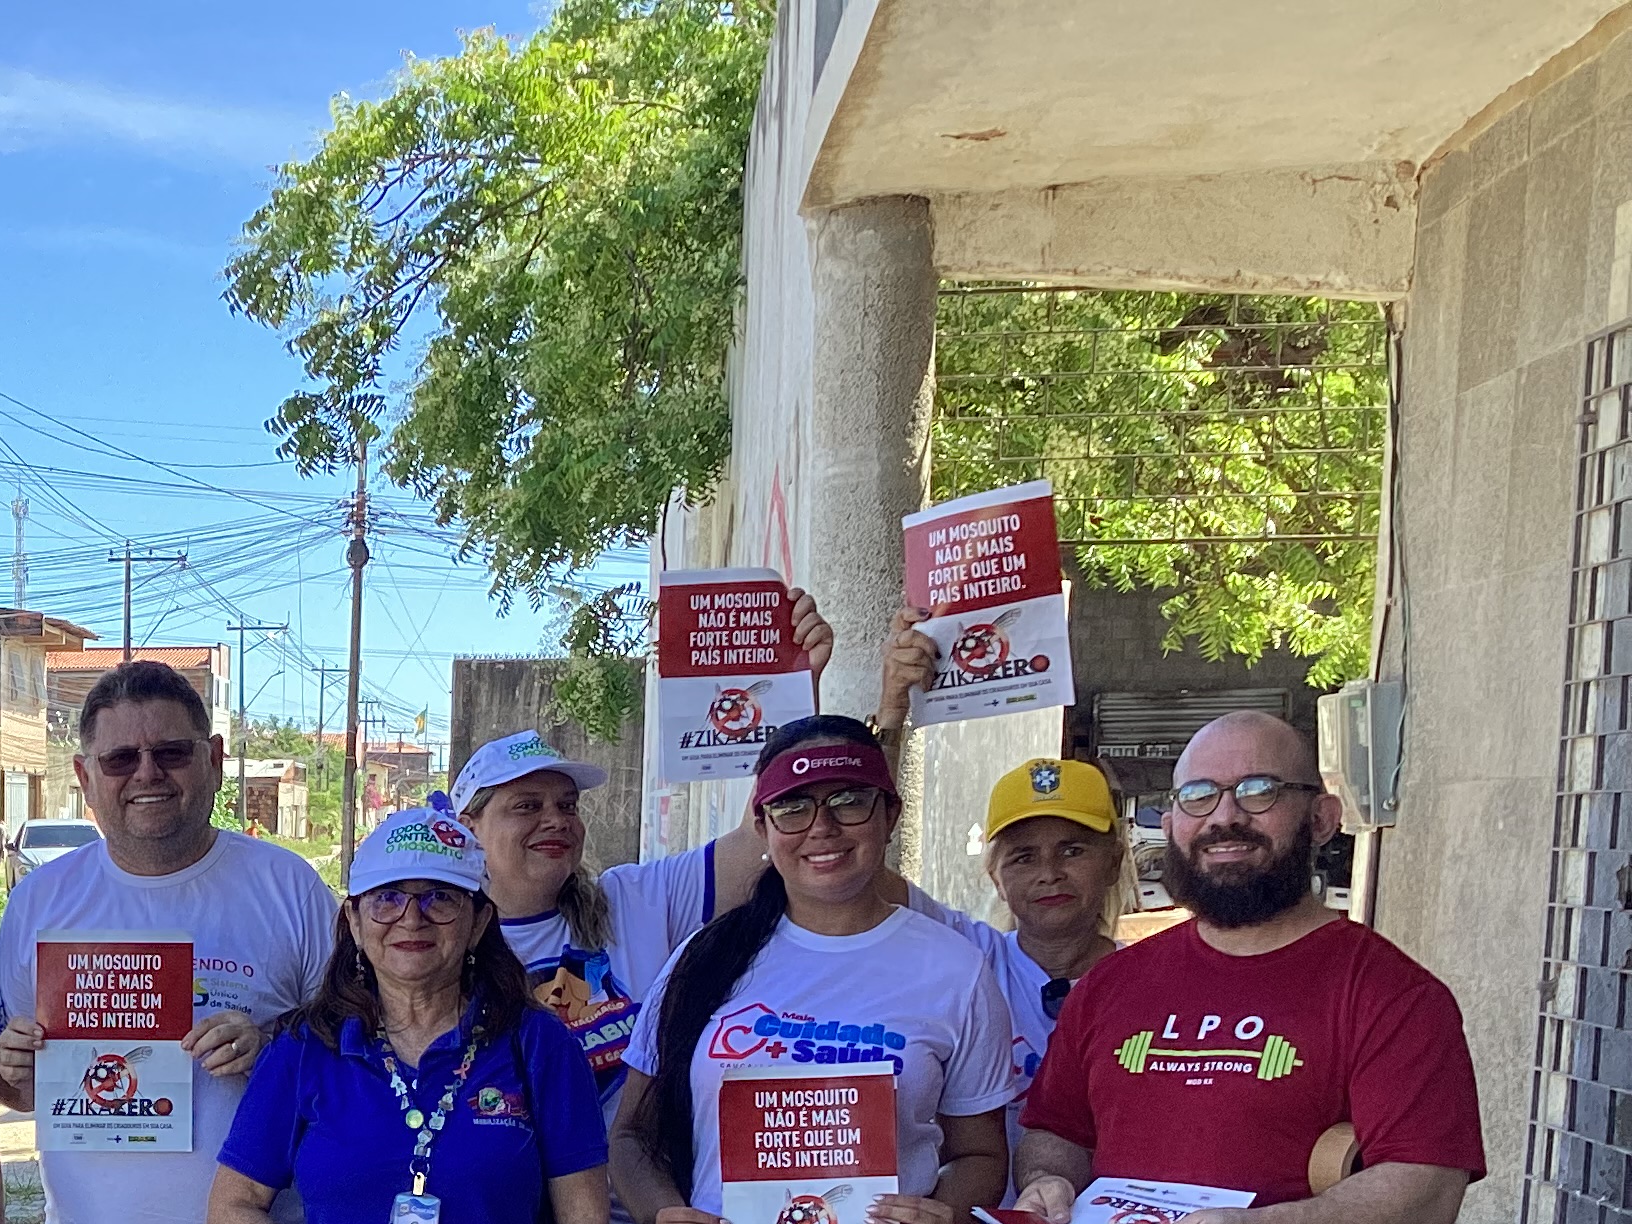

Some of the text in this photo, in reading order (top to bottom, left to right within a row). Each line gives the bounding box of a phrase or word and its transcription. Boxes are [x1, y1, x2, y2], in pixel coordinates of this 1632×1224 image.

[928, 514, 1020, 548] UM MOSQUITO
[936, 536, 1014, 566] NÃO É MAIS
[928, 553, 1026, 587] FORTE QUE UM
[930, 574, 1026, 606] PAÍS INTEIRO.
[690, 592, 780, 610] UM MOSQUITO
[698, 608, 772, 628] NÃO É MAIS
[690, 629, 780, 648] FORTE QUE UM
[692, 645, 778, 666] PAÍS INTEIRO.
[810, 756, 863, 768] EFFECTIVE
[386, 832, 438, 844] CONTRA
[391, 823, 429, 838] TODOS
[386, 841, 463, 860] O MOSQUITO
[68, 954, 162, 970] UM MOSQUITO
[243, 965, 254, 978] O
[76, 970, 154, 990] NÃO É MAIS
[66, 992, 162, 1009] FORTE QUE UM
[210, 1000, 222, 1008] de
[68, 1008, 160, 1028] PAÍS INTEIRO.
[754, 1014, 906, 1050] Cuidado
[1149, 1062, 1253, 1073] ALWAYS STRONG
[755, 1088, 858, 1108] UM MOSQUITO
[764, 1106, 850, 1128] NÃO É MAIS
[755, 1128, 860, 1148] FORTE QUE UM
[758, 1148, 860, 1168] PAÍS INTEIRO.
